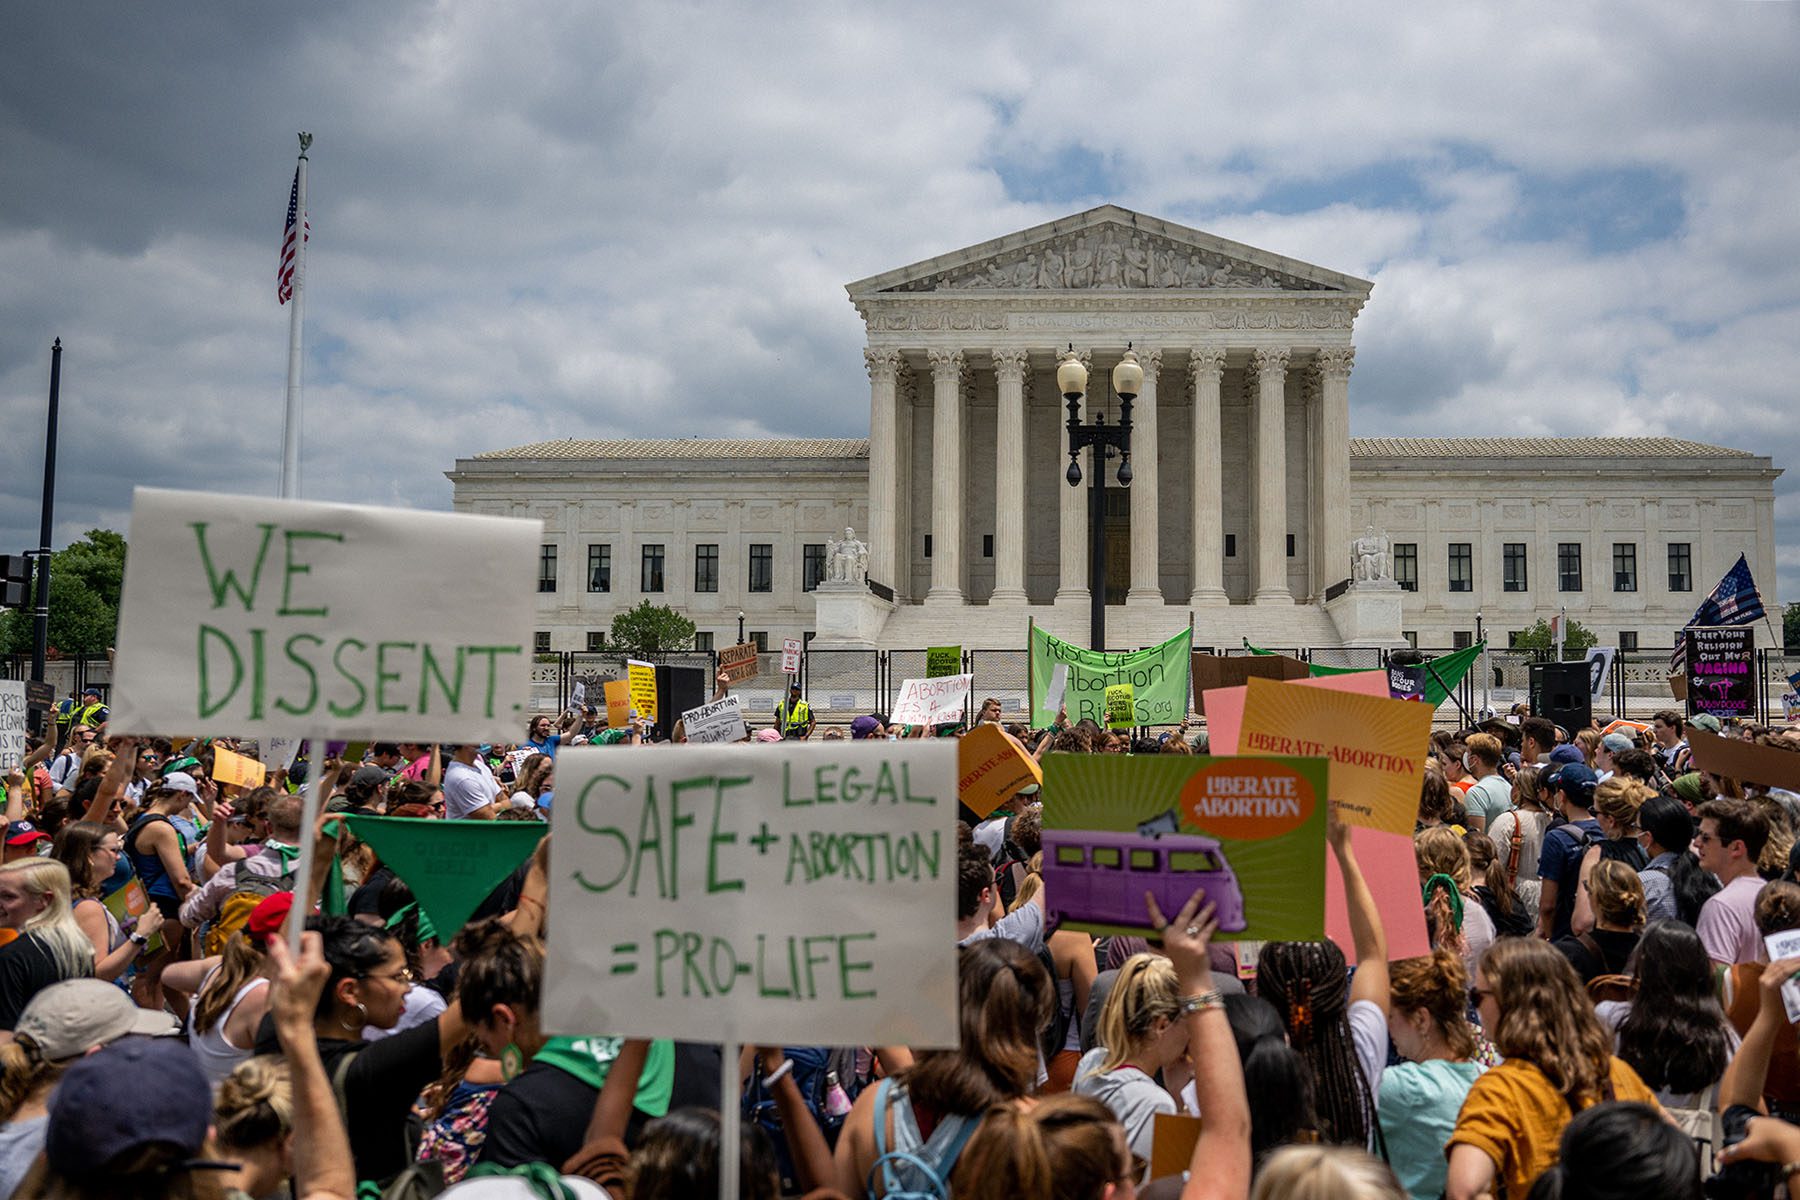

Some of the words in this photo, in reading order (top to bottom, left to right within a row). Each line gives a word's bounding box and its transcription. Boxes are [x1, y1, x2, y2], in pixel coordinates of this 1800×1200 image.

[1018, 316, 1062, 327] EQUAL
[1064, 316, 1118, 327] JUSTICE
[1126, 316, 1168, 327] UNDER
[1175, 316, 1200, 327] LAW
[188, 521, 345, 618] WE
[721, 643, 756, 664] SEPARATE
[1694, 662, 1748, 674] VAGINA
[198, 624, 523, 721] DISSENT.
[907, 677, 970, 700] ABORTION
[901, 701, 920, 713] IS
[930, 700, 941, 711] A
[1247, 731, 1325, 756] LIBERATE
[1327, 744, 1416, 776] ABORTION
[782, 760, 937, 808] LEGAL
[1206, 776, 1297, 796] LIBERATE
[1194, 797, 1301, 818] ABORTION
[571, 772, 754, 900] SAFE
[785, 830, 941, 885] ABORTION
[653, 929, 877, 1000] PRO-LIFE
